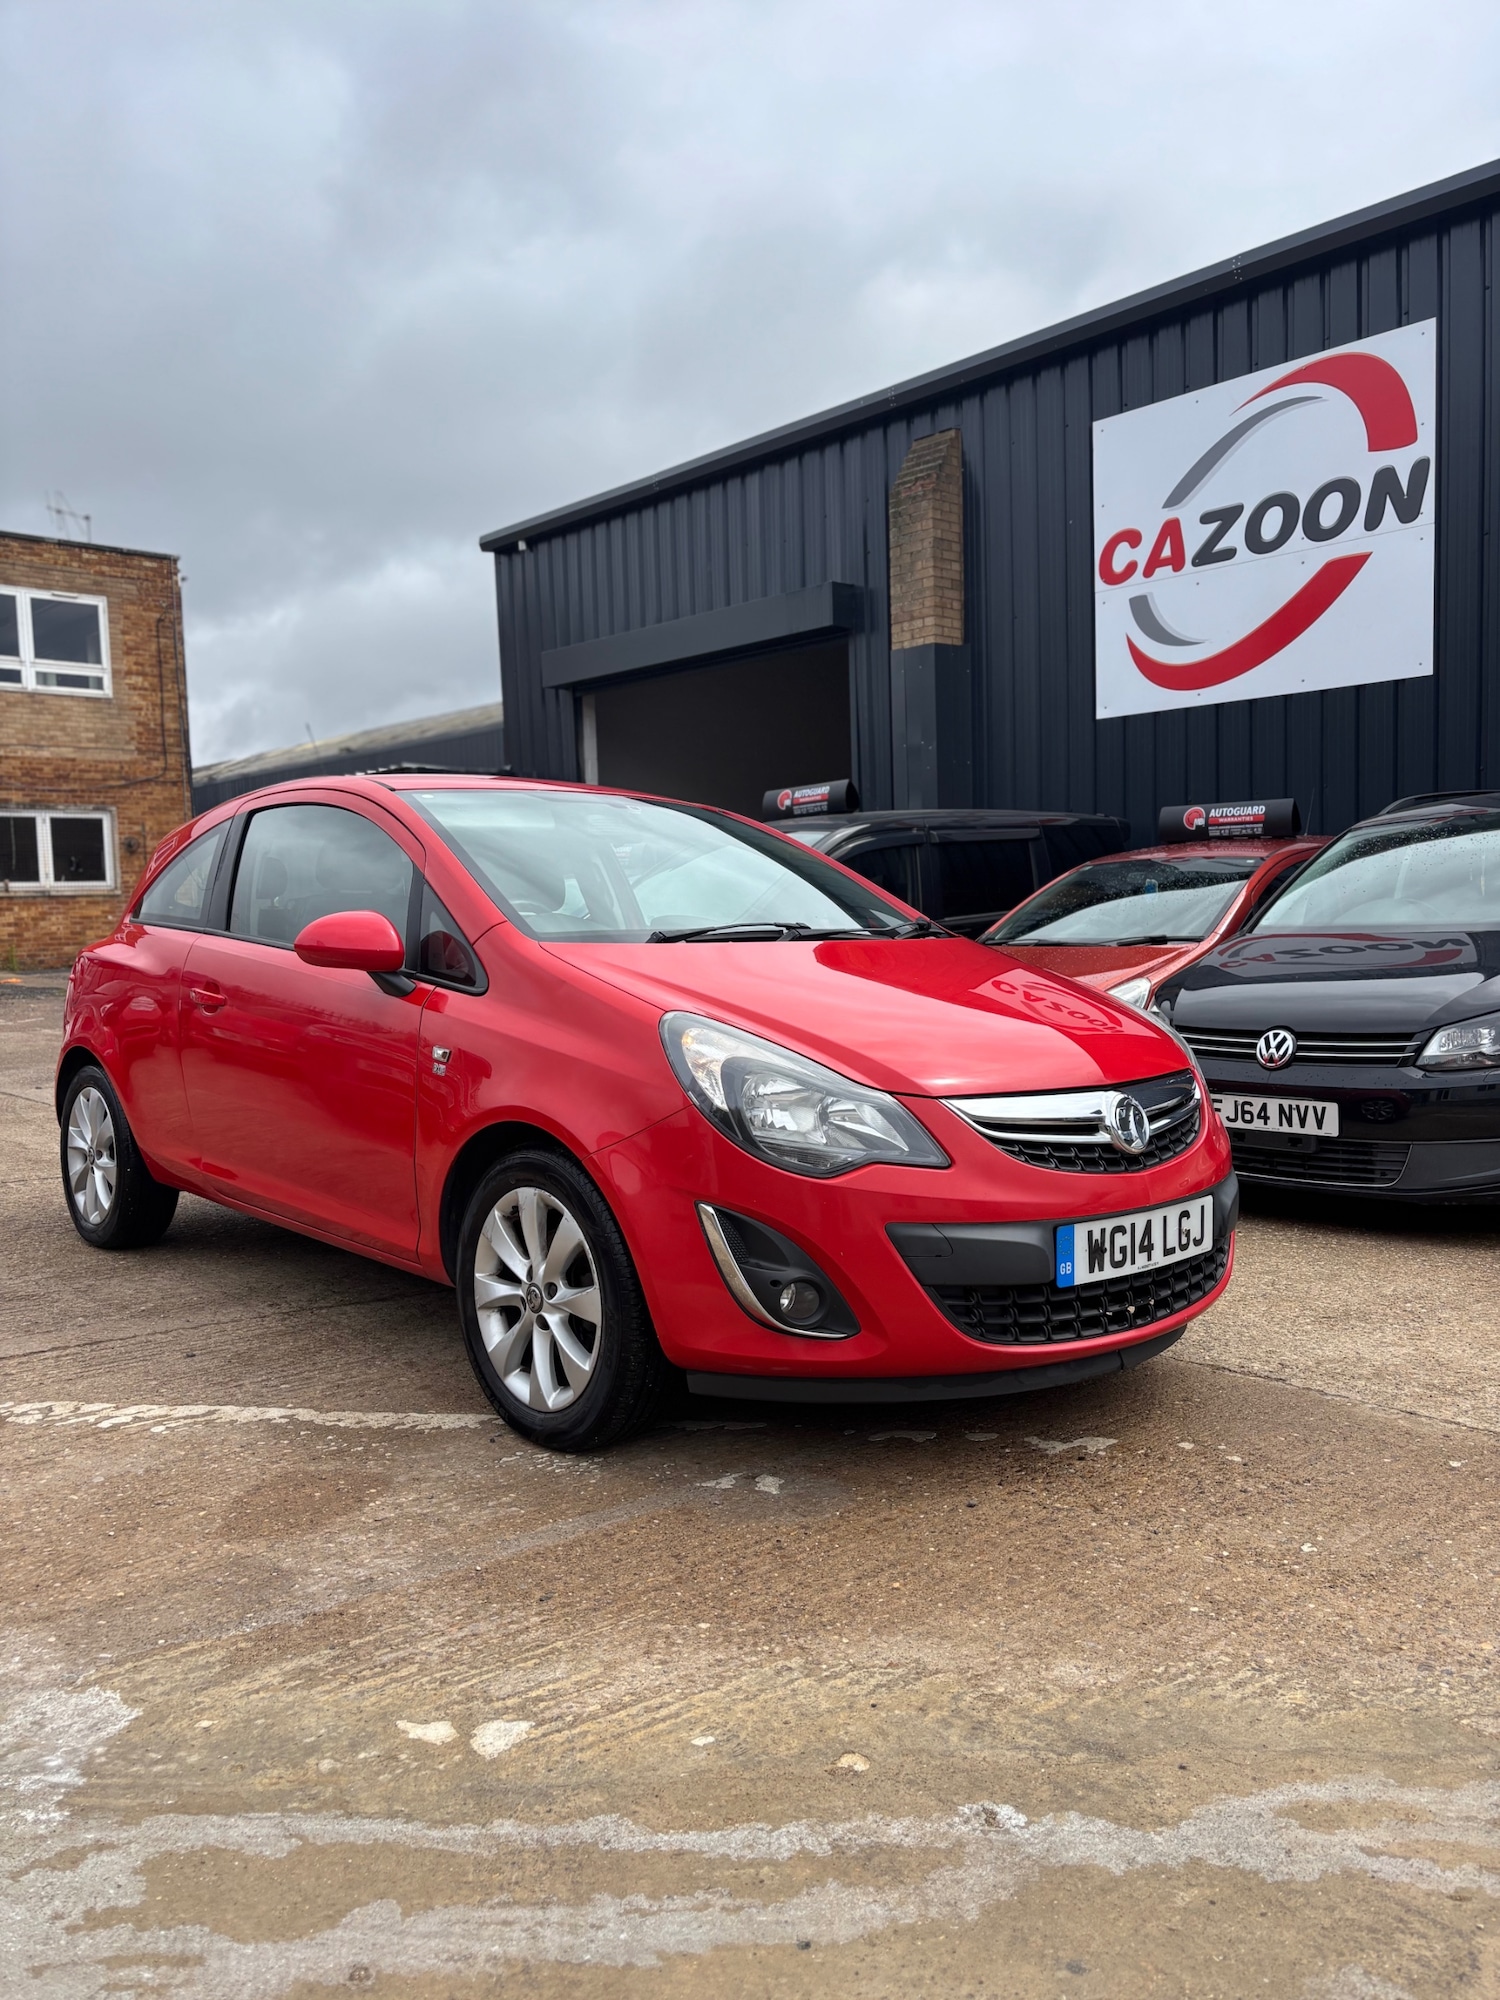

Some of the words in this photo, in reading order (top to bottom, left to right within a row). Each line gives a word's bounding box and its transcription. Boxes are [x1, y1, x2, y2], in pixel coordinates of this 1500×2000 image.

[1098, 456, 1431, 586] CAZOON
[793, 786, 830, 798] AUTOGUARD
[1209, 805, 1266, 818] AUTOGUARD
[1278, 1103, 1327, 1131] NVV
[1087, 1219, 1155, 1274] WG14
[1162, 1204, 1205, 1258] LGJ
[1059, 1261, 1073, 1276] GB
